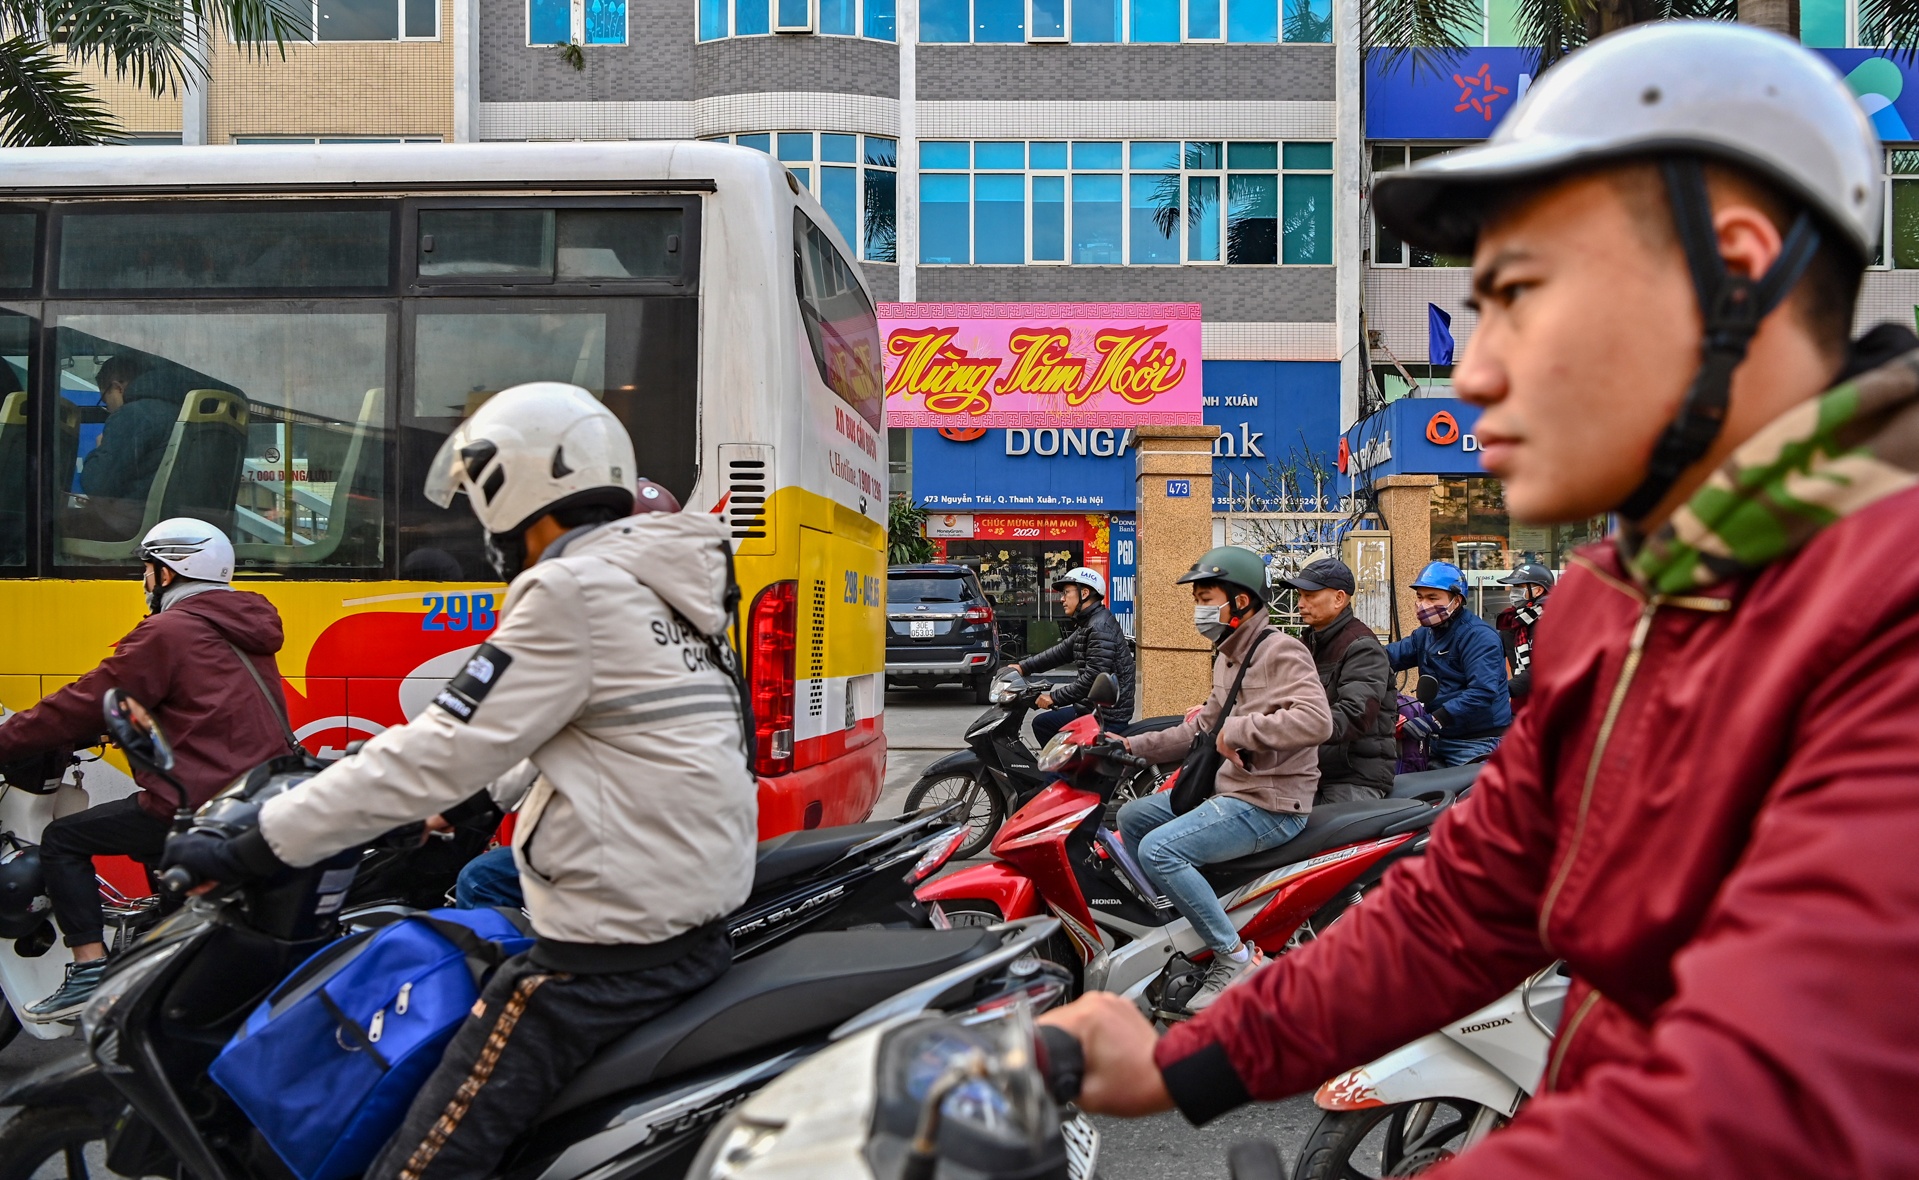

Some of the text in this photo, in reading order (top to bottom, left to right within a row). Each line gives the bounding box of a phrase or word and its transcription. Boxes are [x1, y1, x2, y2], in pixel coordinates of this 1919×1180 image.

[885, 326, 1002, 416] Mừng
[996, 326, 1087, 395] Năm
[1065, 324, 1186, 405] Mới
[1225, 393, 1258, 407] XUÂN
[1169, 483, 1188, 494] 473
[1009, 495, 1034, 504] Thanh
[1076, 496, 1087, 504] Hà
[1089, 496, 1103, 506] Nội
[982, 517, 1005, 527] CHÚC
[1037, 518, 1057, 528] NĂM
[1060, 517, 1077, 528] MỚI
[1013, 528, 1040, 537] 2020
[1117, 540, 1133, 565] PGD
[844, 570, 858, 604] 29B
[1113, 576, 1133, 602] THAN
[422, 592, 496, 631] 29B
[911, 629, 934, 637] 053.03
[767, 885, 844, 924] BLADE
[1460, 1017, 1513, 1035] HONDA
